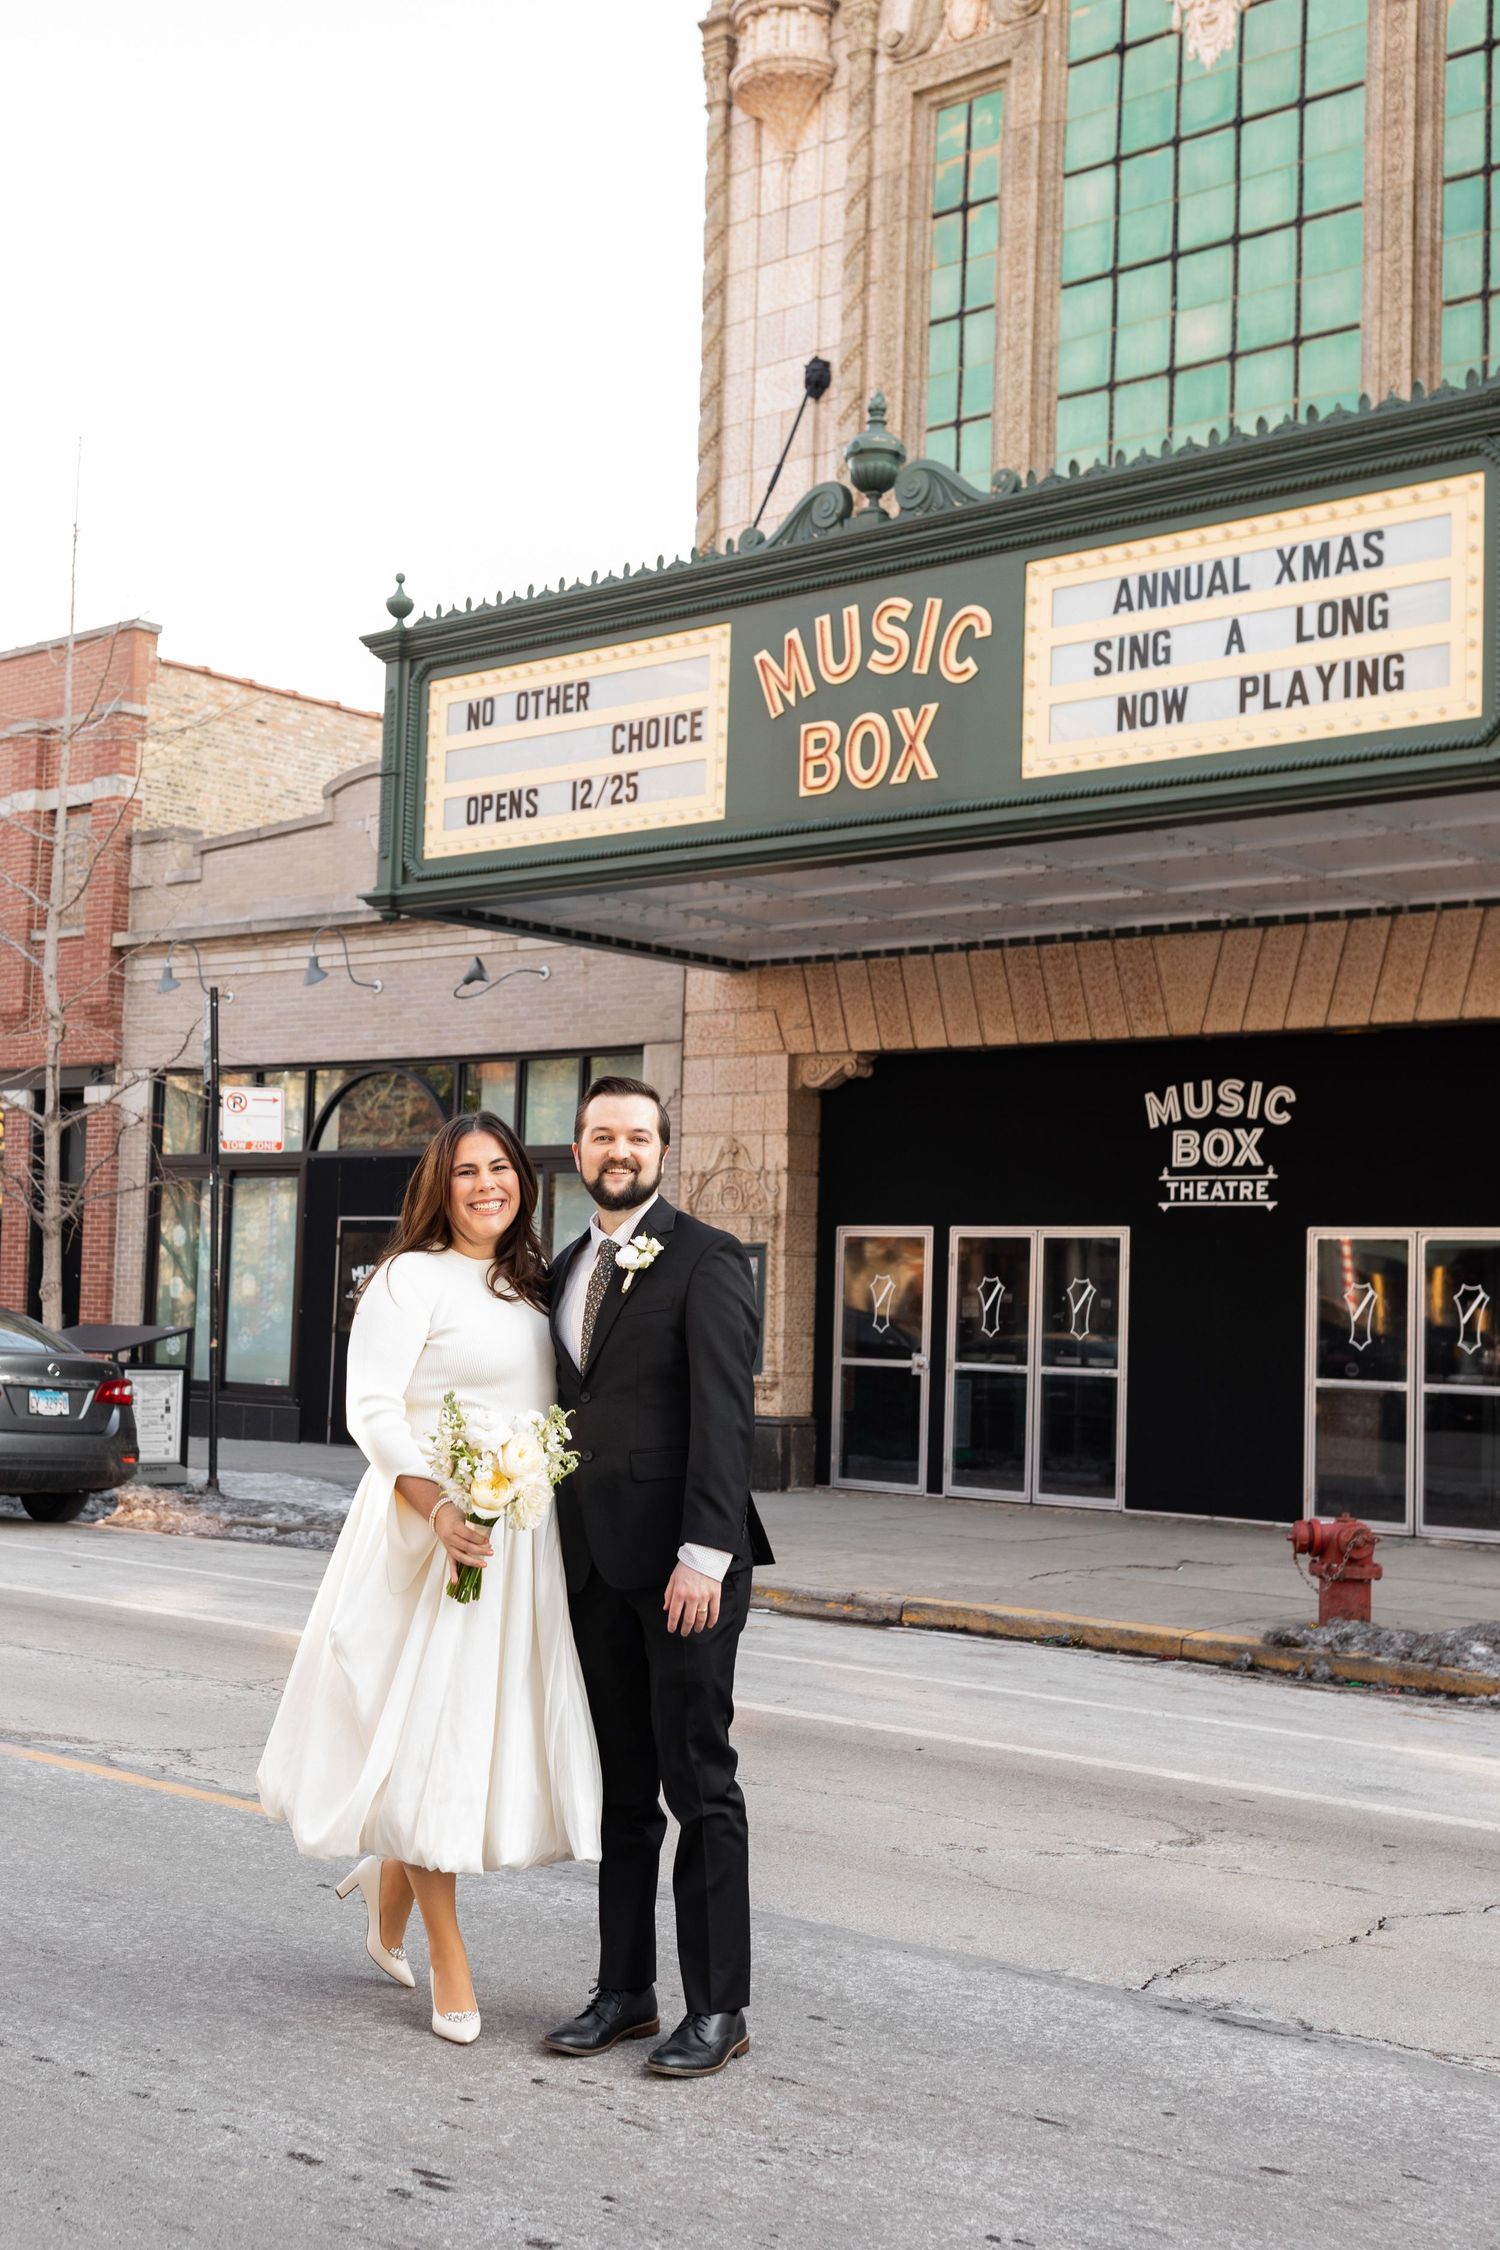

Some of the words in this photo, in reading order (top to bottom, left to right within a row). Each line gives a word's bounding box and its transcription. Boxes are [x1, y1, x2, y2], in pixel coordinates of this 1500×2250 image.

[1112, 556, 1251, 615] ANNUAL
[1275, 530, 1384, 585] XMAS
[753, 596, 993, 720] MUSIC
[1094, 629, 1171, 677] SING
[1224, 618, 1246, 656] A
[1296, 592, 1389, 644] LONG
[467, 697, 495, 731] NO
[516, 681, 590, 722] OTHER
[1117, 686, 1189, 732] NOW
[1239, 653, 1405, 714] PLAYING
[612, 710, 702, 755] CHOICE
[798, 702, 940, 798] BOX
[466, 788, 539, 826] OPENS
[571, 771, 639, 811] 12/25
[1144, 1078, 1297, 1129] MUSIC
[1171, 1128, 1265, 1168] BOX
[1165, 1180, 1269, 1201] THEATRE
